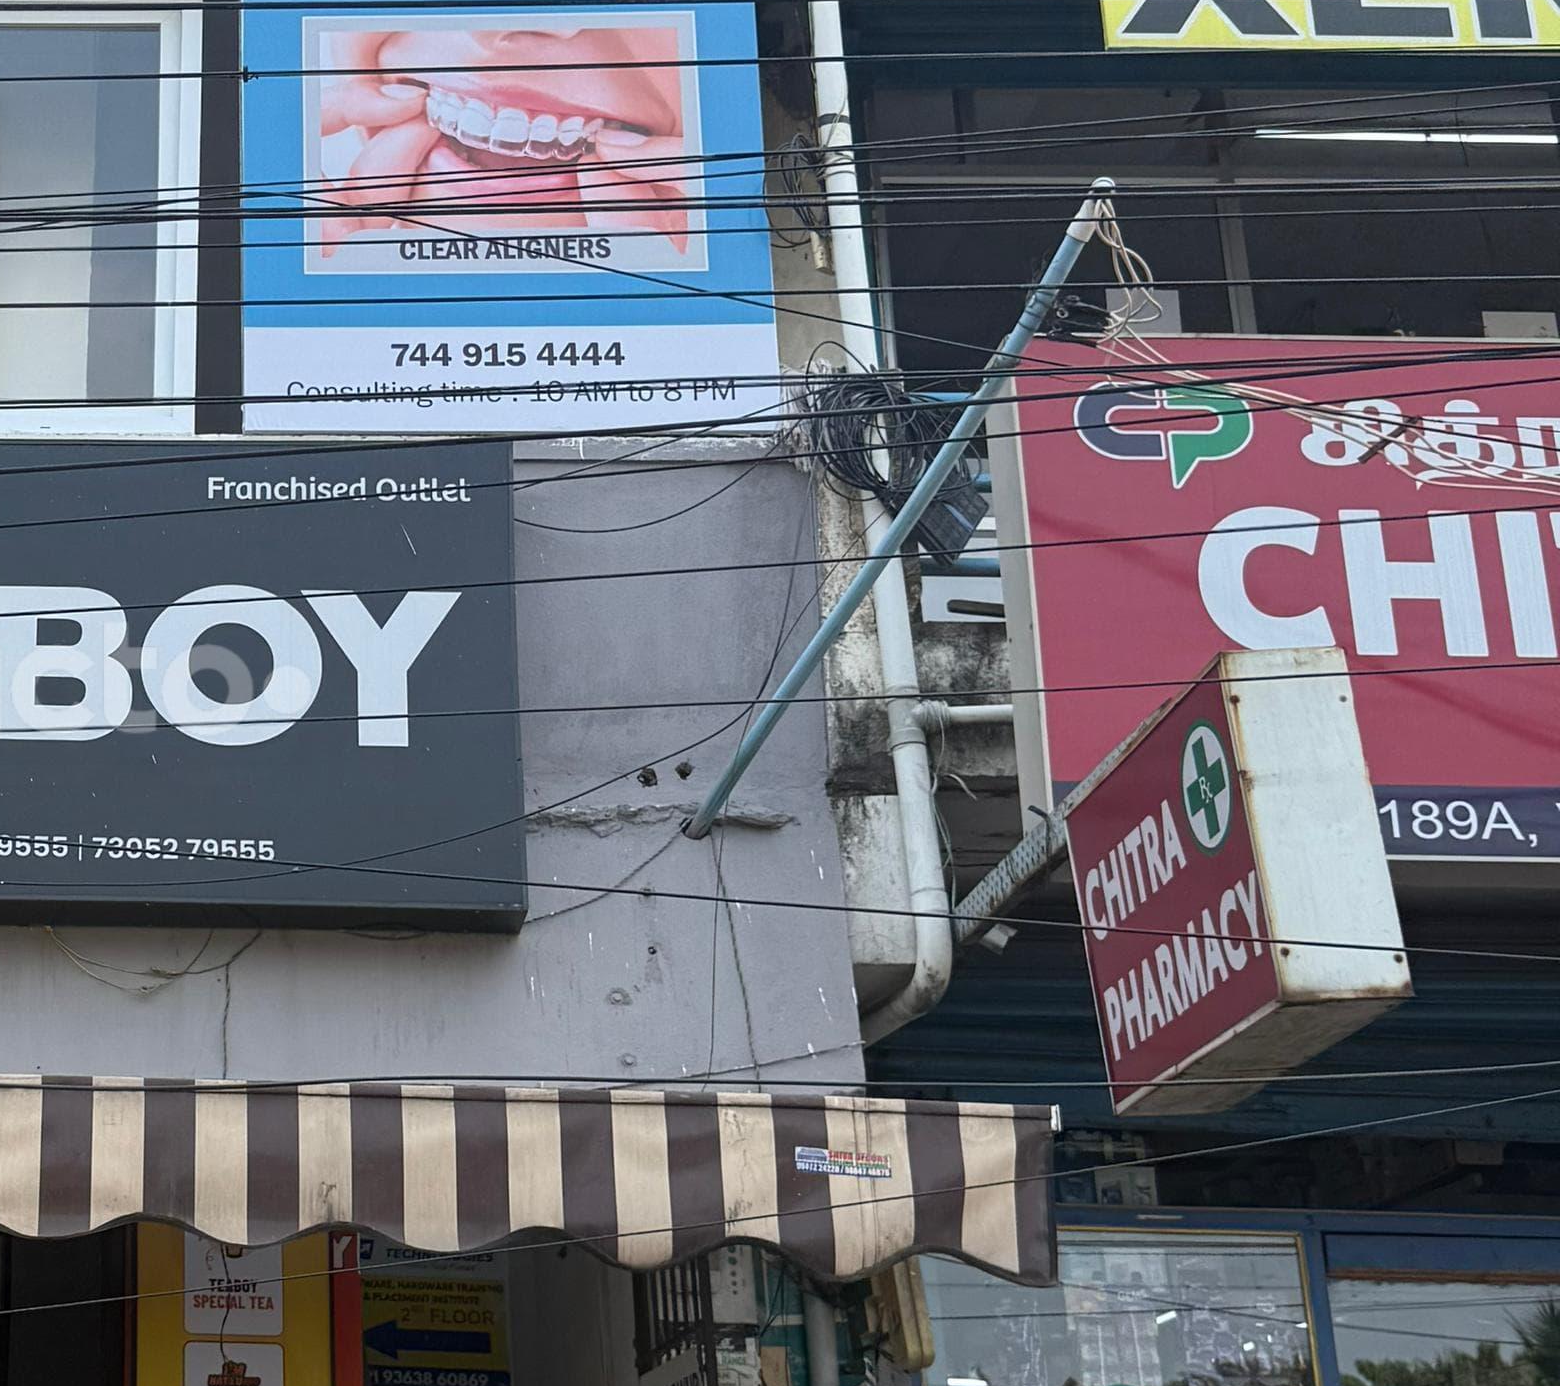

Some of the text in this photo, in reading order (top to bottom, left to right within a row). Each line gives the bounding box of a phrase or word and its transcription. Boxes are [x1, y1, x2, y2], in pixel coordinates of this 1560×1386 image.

[400, 237, 611, 261] CLEAR ALIGNERS
[391, 342, 625, 367] 744 915 4444
[206, 476, 471, 502] Franchised Outlet
[1084, 800, 1187, 942] CHITRA
[1103, 870, 1263, 1062] PHARMACY
[193, 1296, 274, 1311] SPECIAL TEA
